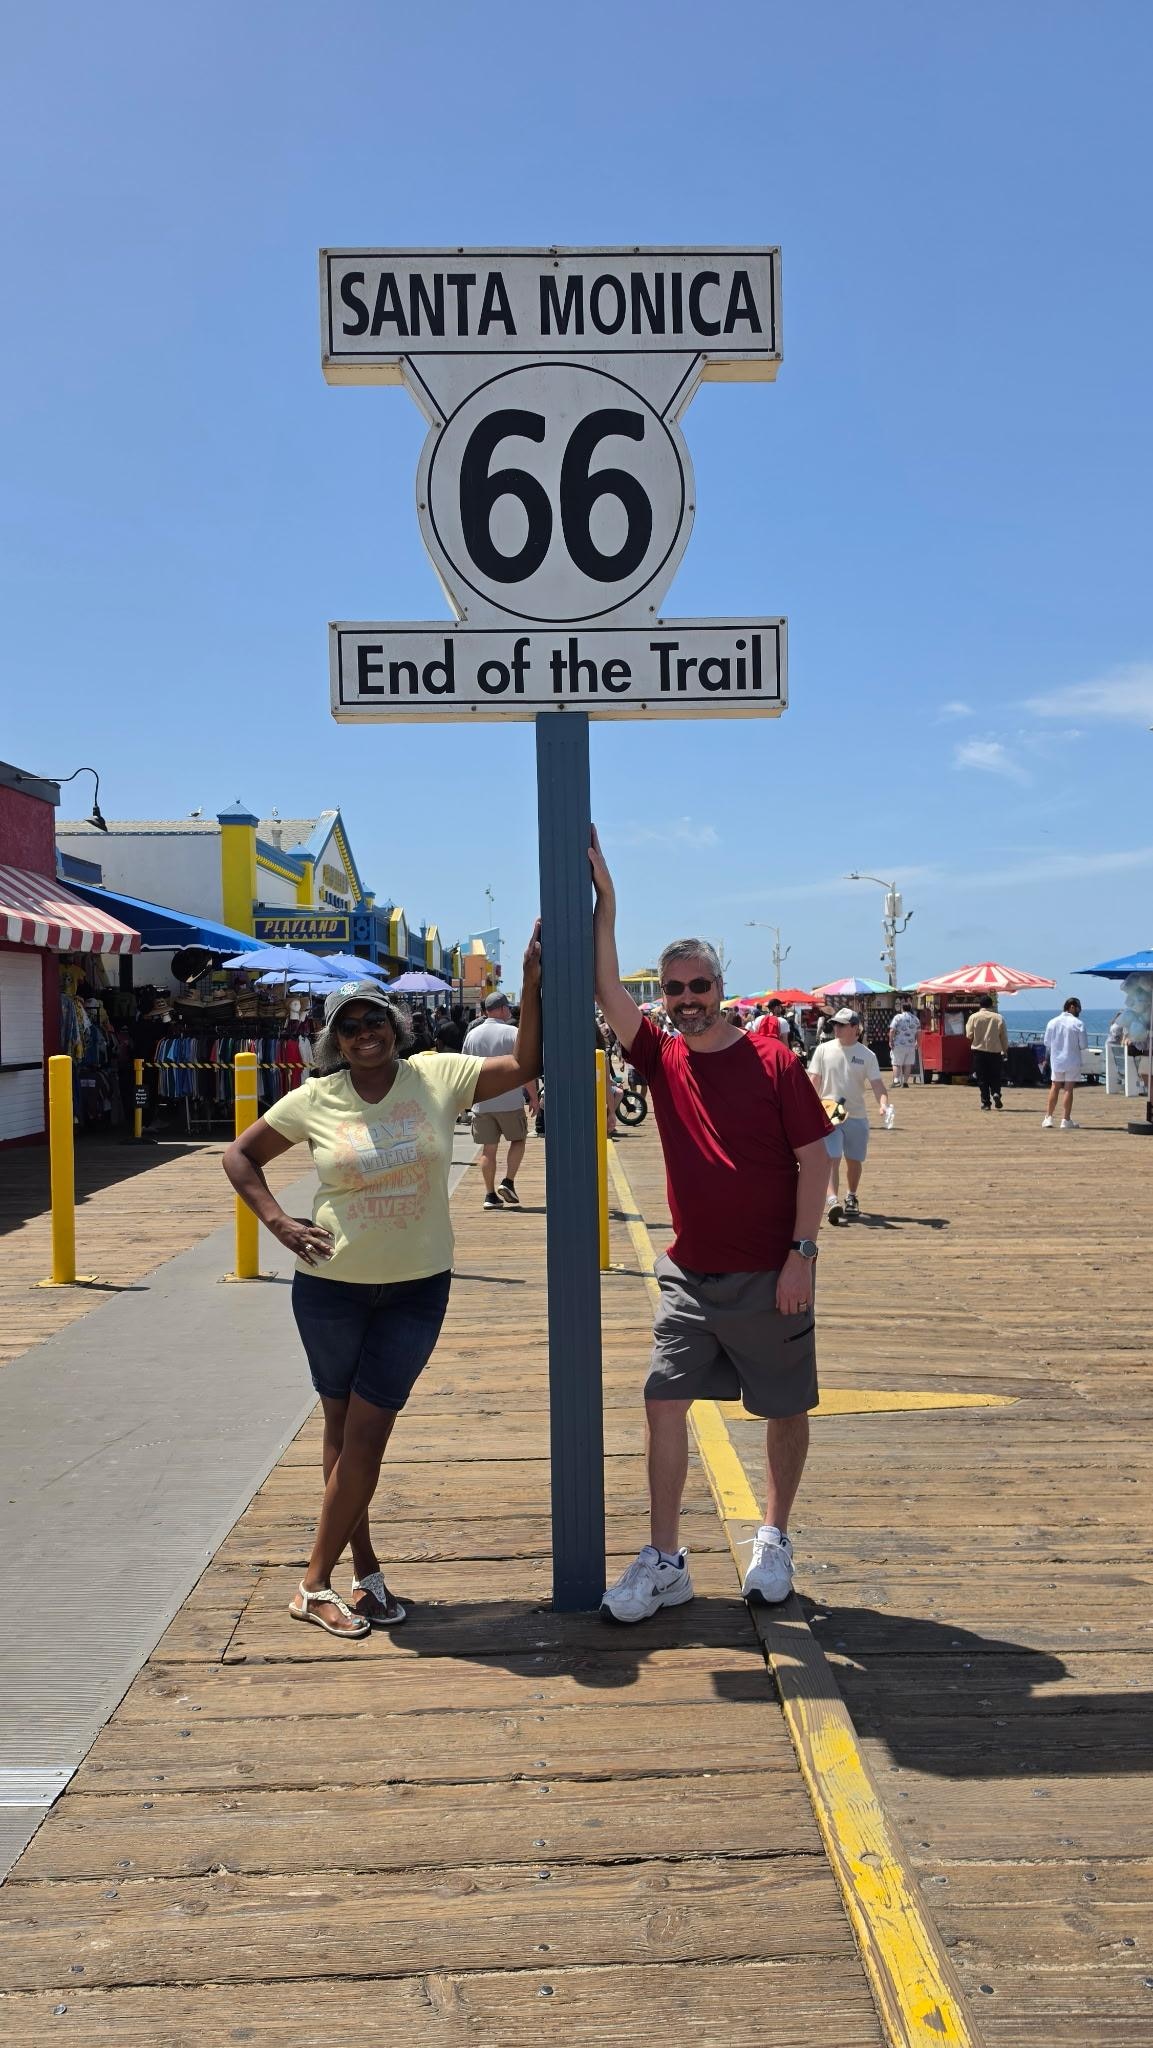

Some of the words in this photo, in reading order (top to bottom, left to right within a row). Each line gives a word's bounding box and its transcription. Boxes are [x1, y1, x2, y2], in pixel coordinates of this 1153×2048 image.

[340, 271, 517, 337] SANTA
[539, 269, 762, 337] MONICA
[459, 407, 653, 584] 66
[357, 638, 454, 695] End
[477, 637, 531, 694] of
[550, 637, 632, 694] the
[650, 634, 762, 693] Trail
[264, 920, 338, 933] PLAYLAND
[348, 1118, 417, 1149] LOVE
[360, 1146, 418, 1171] WHERE
